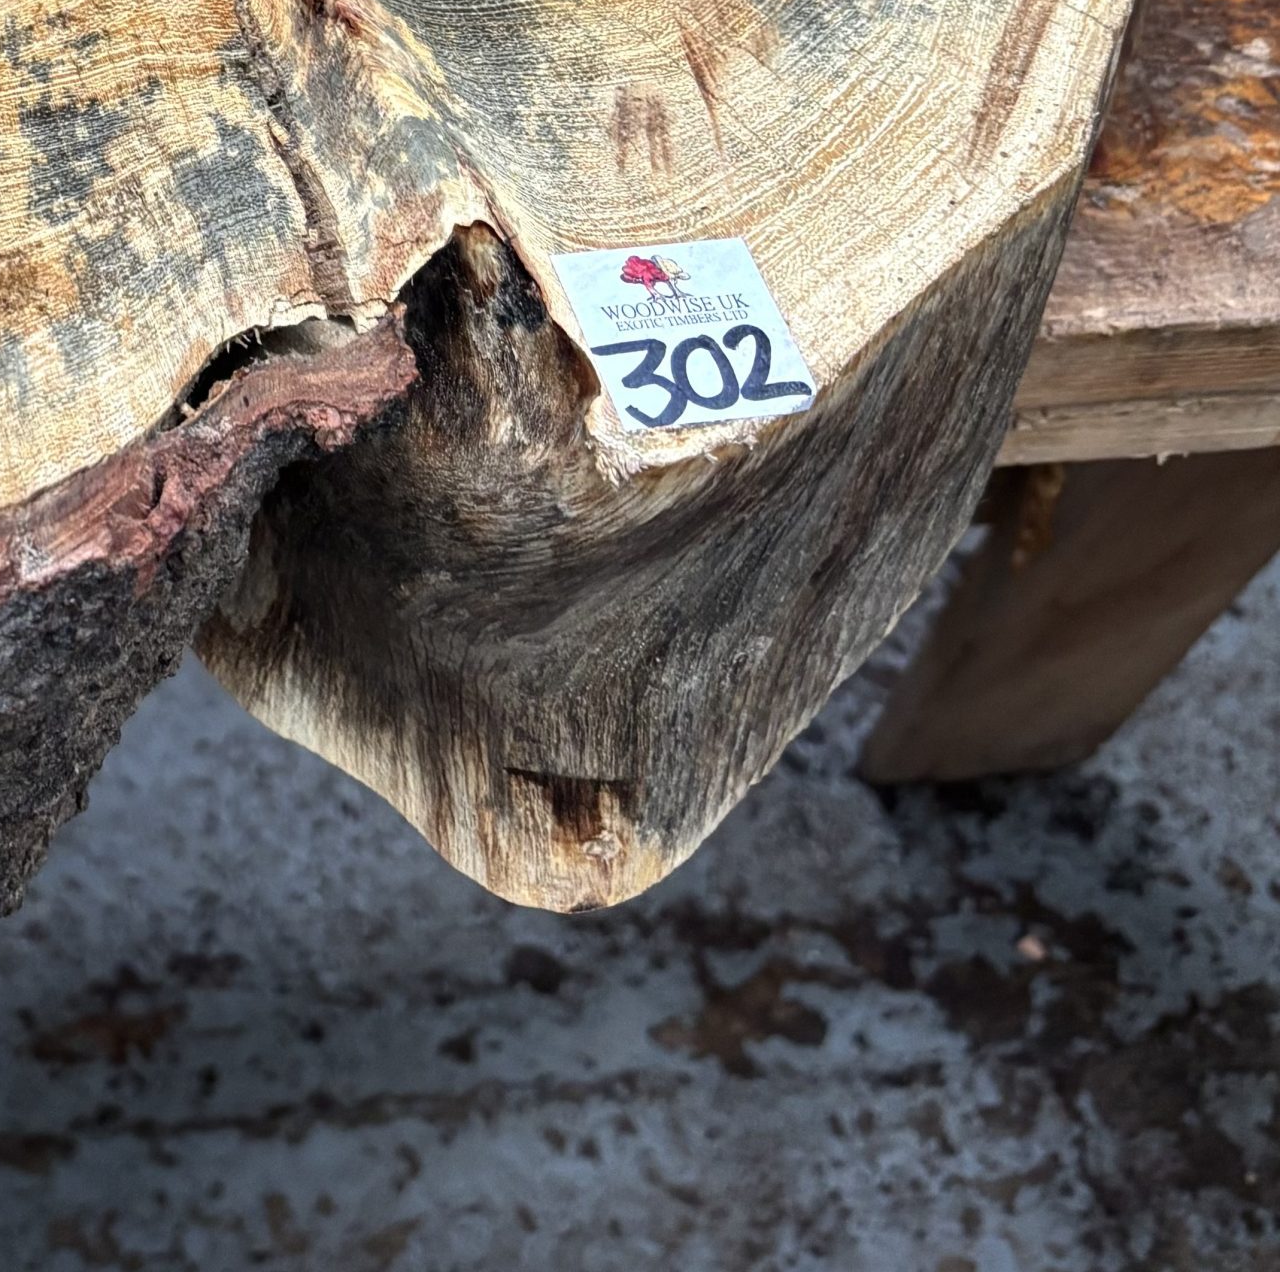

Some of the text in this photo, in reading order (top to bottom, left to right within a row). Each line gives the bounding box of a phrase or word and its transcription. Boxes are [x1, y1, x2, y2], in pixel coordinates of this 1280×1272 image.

[600, 293, 750, 321] WOODWISE UK
[615, 309, 749, 332] EXOTIC TIMBERS LTD
[590, 324, 812, 428] 302
